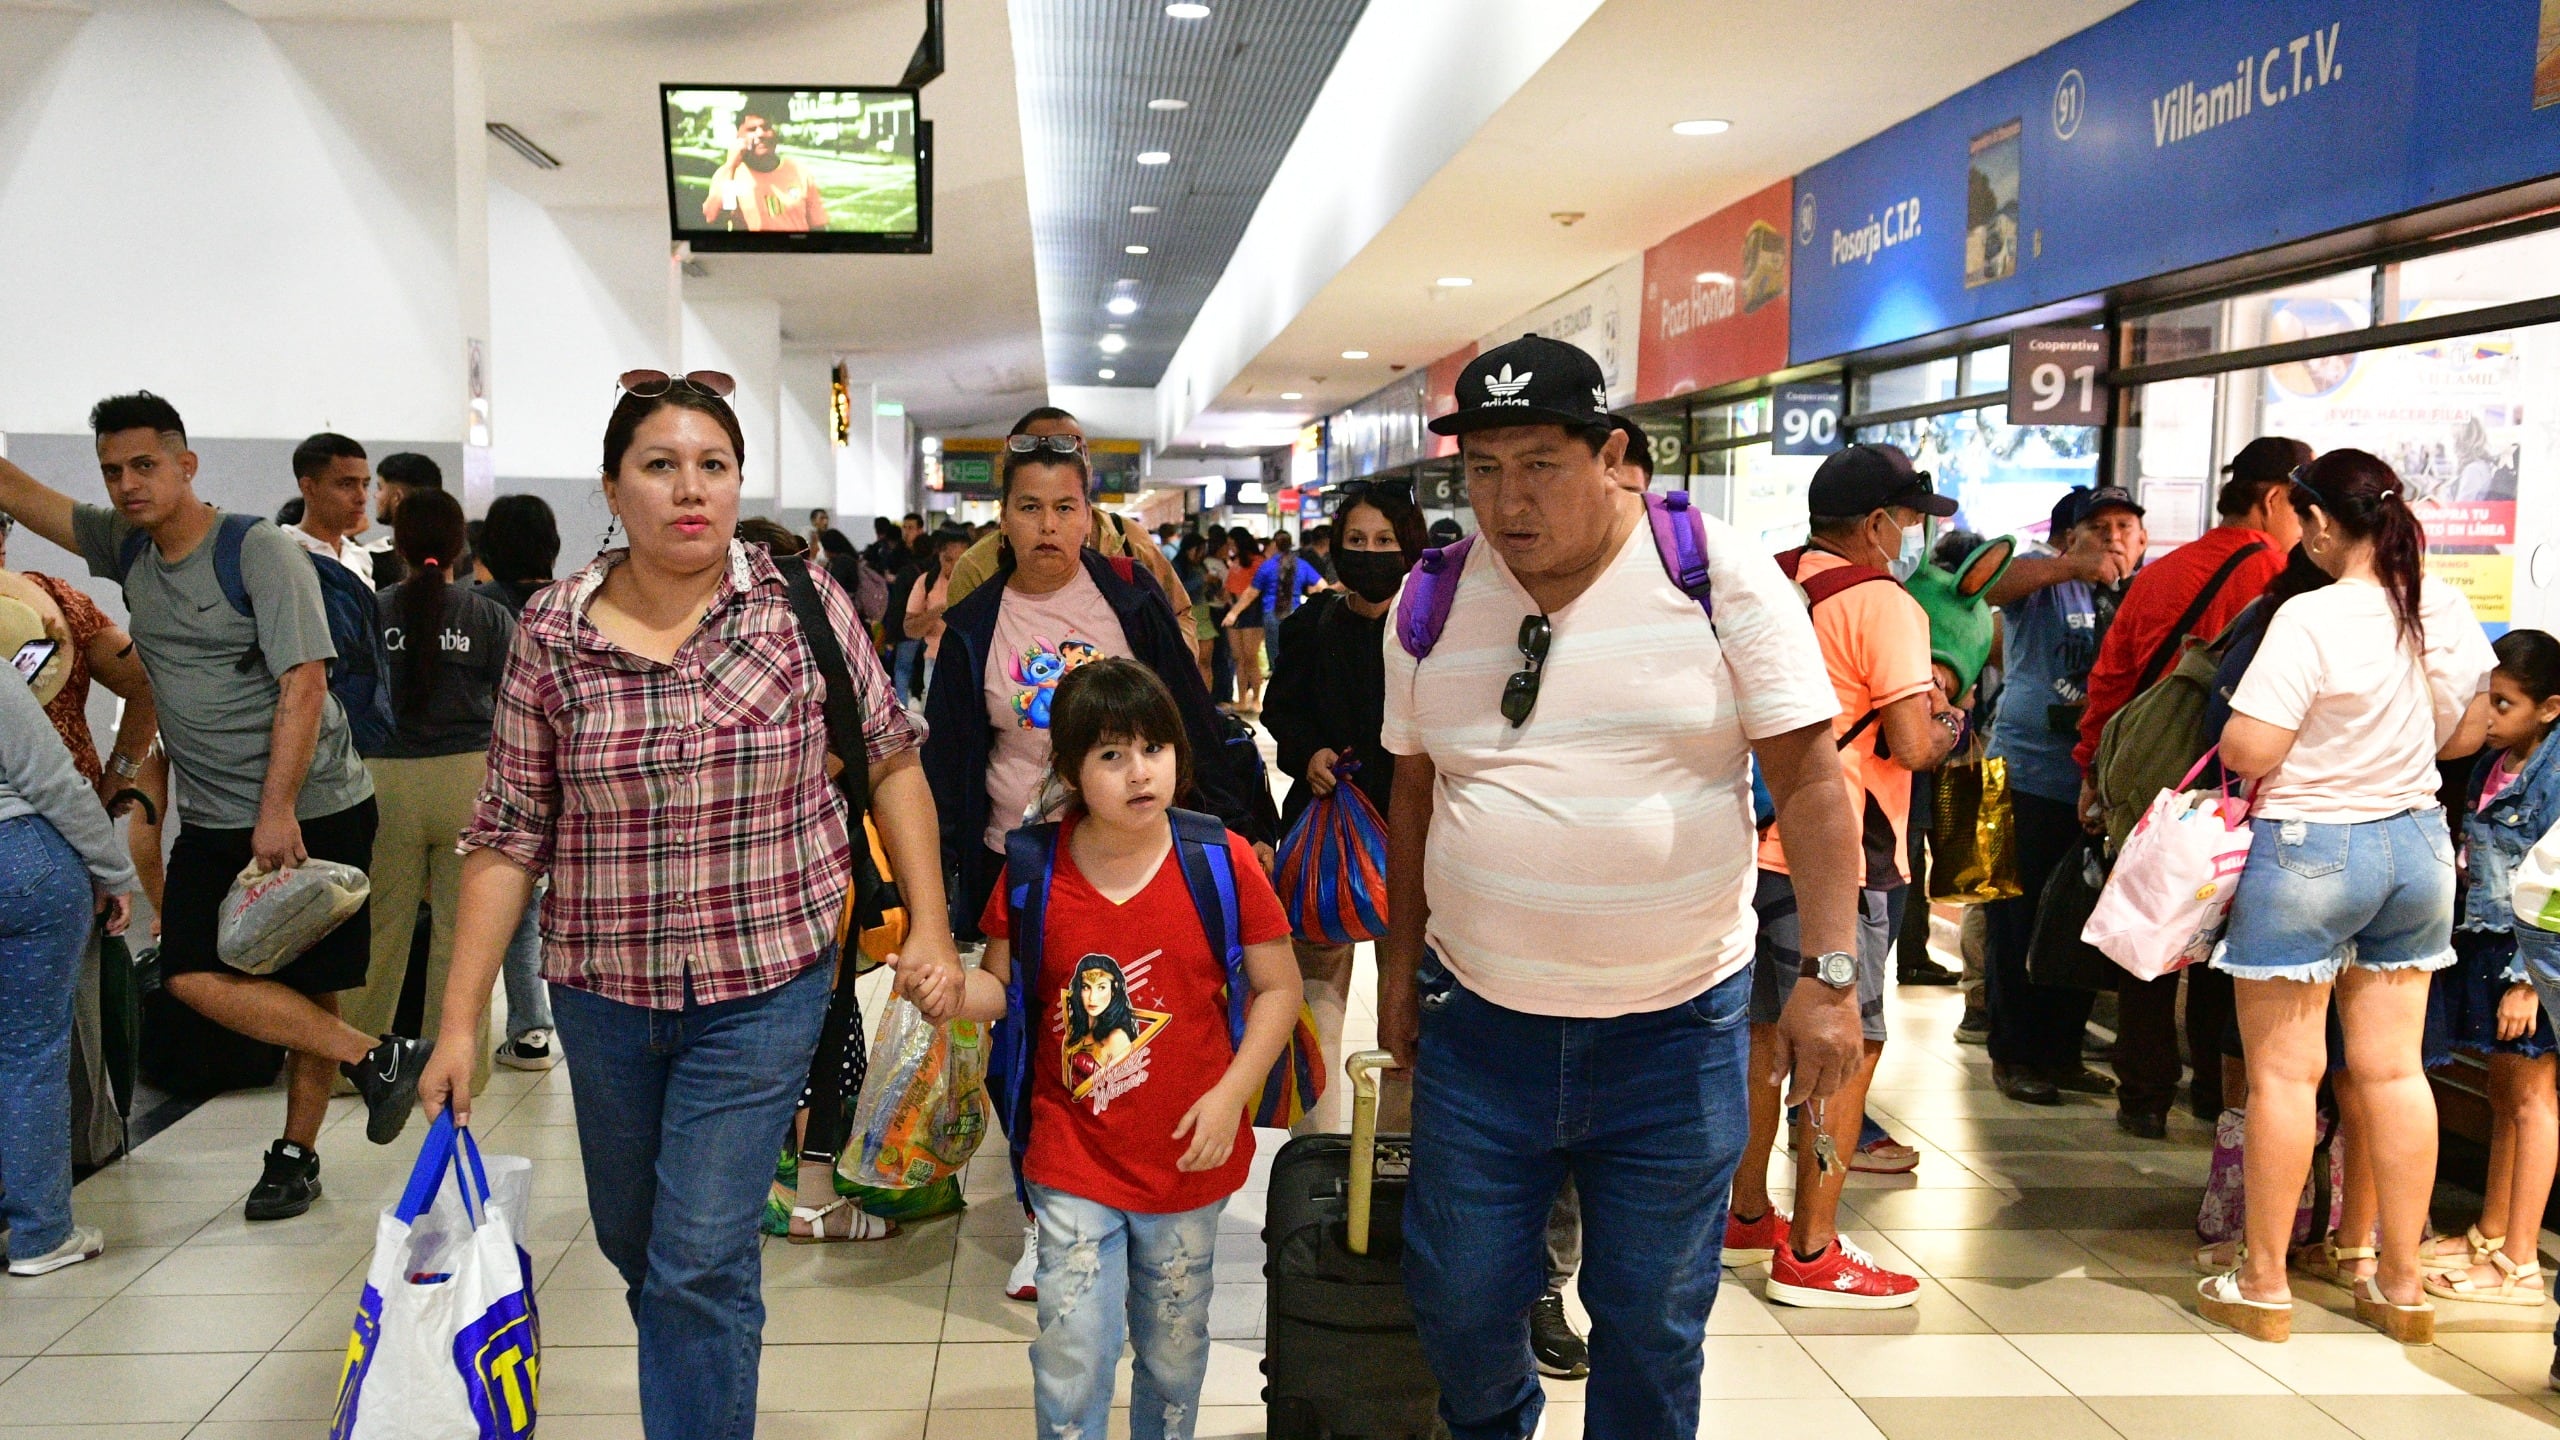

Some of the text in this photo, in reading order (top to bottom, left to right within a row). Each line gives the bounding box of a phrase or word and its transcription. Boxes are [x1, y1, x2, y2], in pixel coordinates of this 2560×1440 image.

[2152, 21, 2343, 148] Villamil C.T.V.
[2058, 84, 2077, 126] 91
[1831, 197, 1923, 268] Posorja C.T.P.
[1661, 280, 1736, 340] Poza Honda
[2028, 339, 2101, 353] Cooperativa
[2030, 363, 2096, 412] 91
[1782, 408, 1838, 445] 90
[2377, 408, 2426, 420] HACER
[2447, 523, 2466, 535] EN
[2468, 520, 2506, 536] LÍNEA
[2472, 508, 2490, 520] TU
